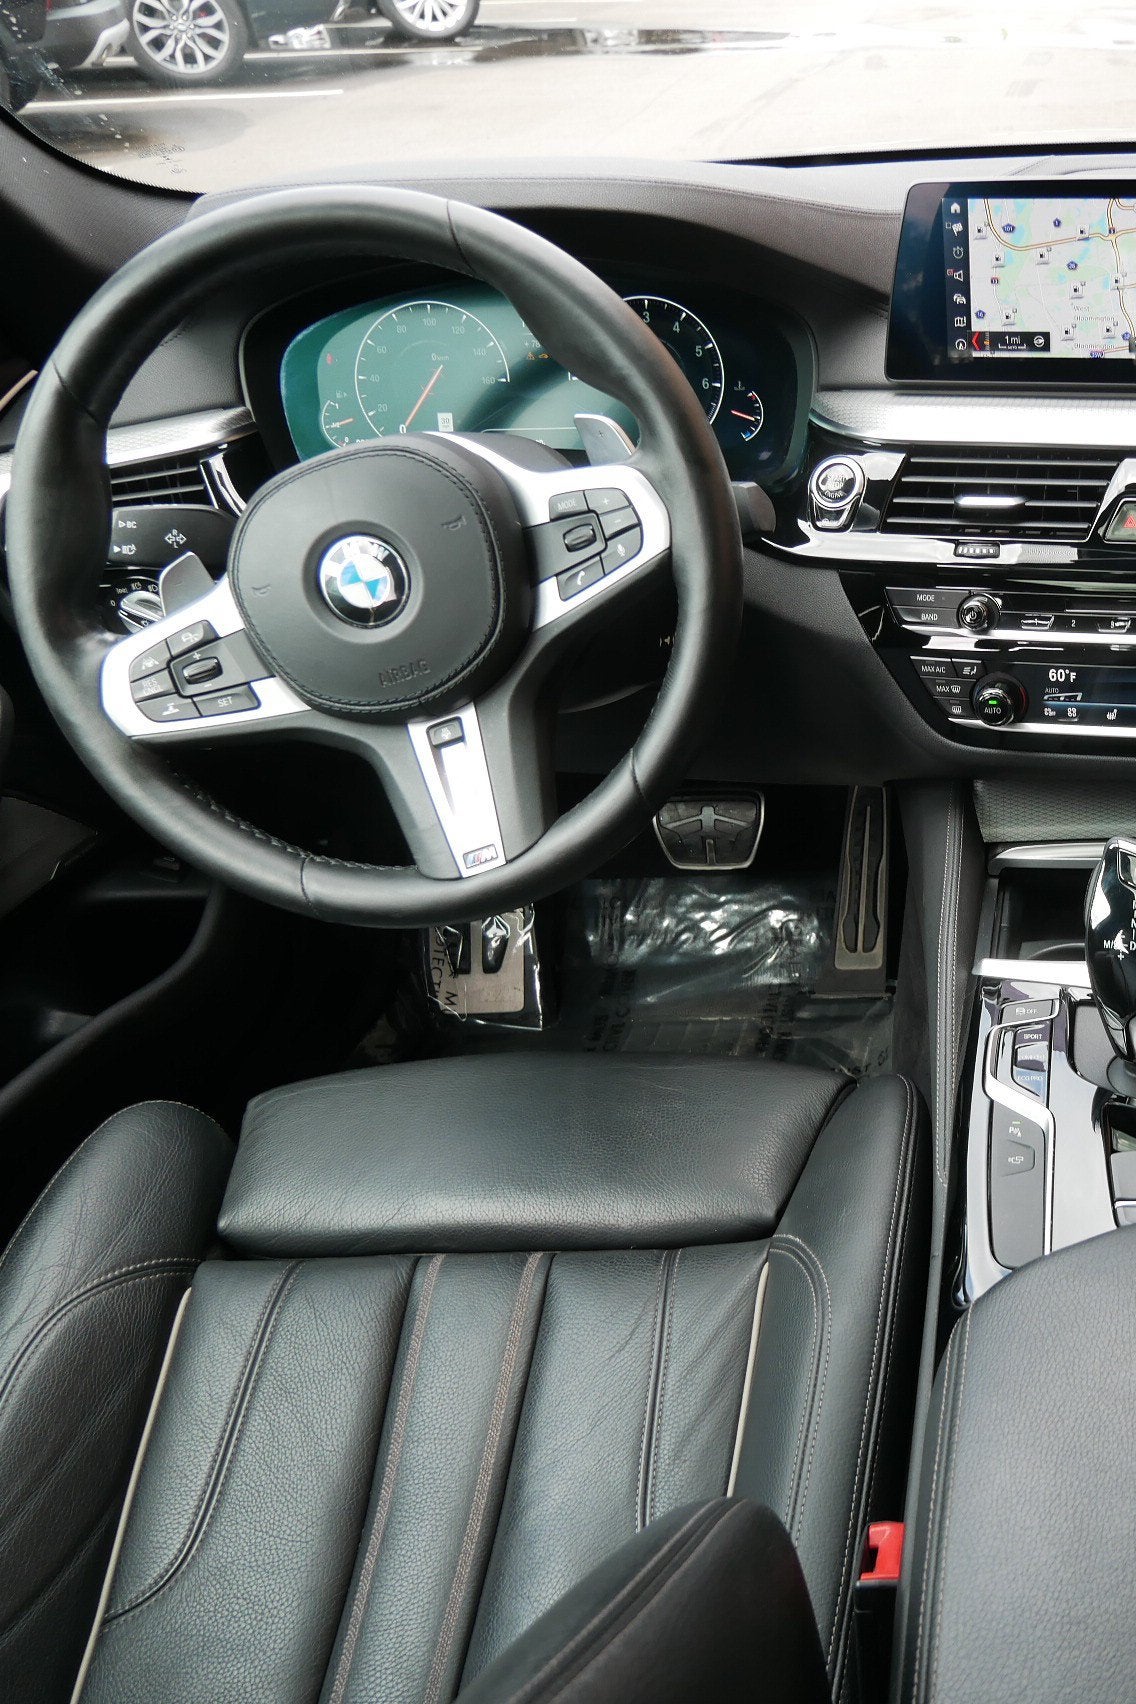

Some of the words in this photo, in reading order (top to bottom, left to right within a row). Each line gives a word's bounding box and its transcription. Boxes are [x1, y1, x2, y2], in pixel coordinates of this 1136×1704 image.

[643, 311, 651, 324] 3
[423, 318, 437, 326] 100
[396, 326, 407, 334] 80
[451, 326, 466, 334] 120
[672, 322, 681, 334] 4
[376, 346, 387, 354] 60
[473, 347, 486, 356] 140
[695, 345, 703, 358] 5
[369, 374, 380, 382] 40
[482, 376, 496, 384] 160
[702, 378, 710, 389] 6
[377, 404, 388, 413] 20
[126, 520, 137, 529] BC
[916, 594, 935, 602] MODE
[921, 613, 938, 621] BAND
[378, 659, 432, 688] AIRBAG
[921, 665, 935, 673] MAX
[935, 665, 946, 674] A/C
[936, 685, 950, 693] MAX
[217, 696, 233, 708] SET
[984, 706, 1002, 714] AUTO
[1129, 940, 1136, 951] D
[1023, 1033, 1043, 1041] SPORT
